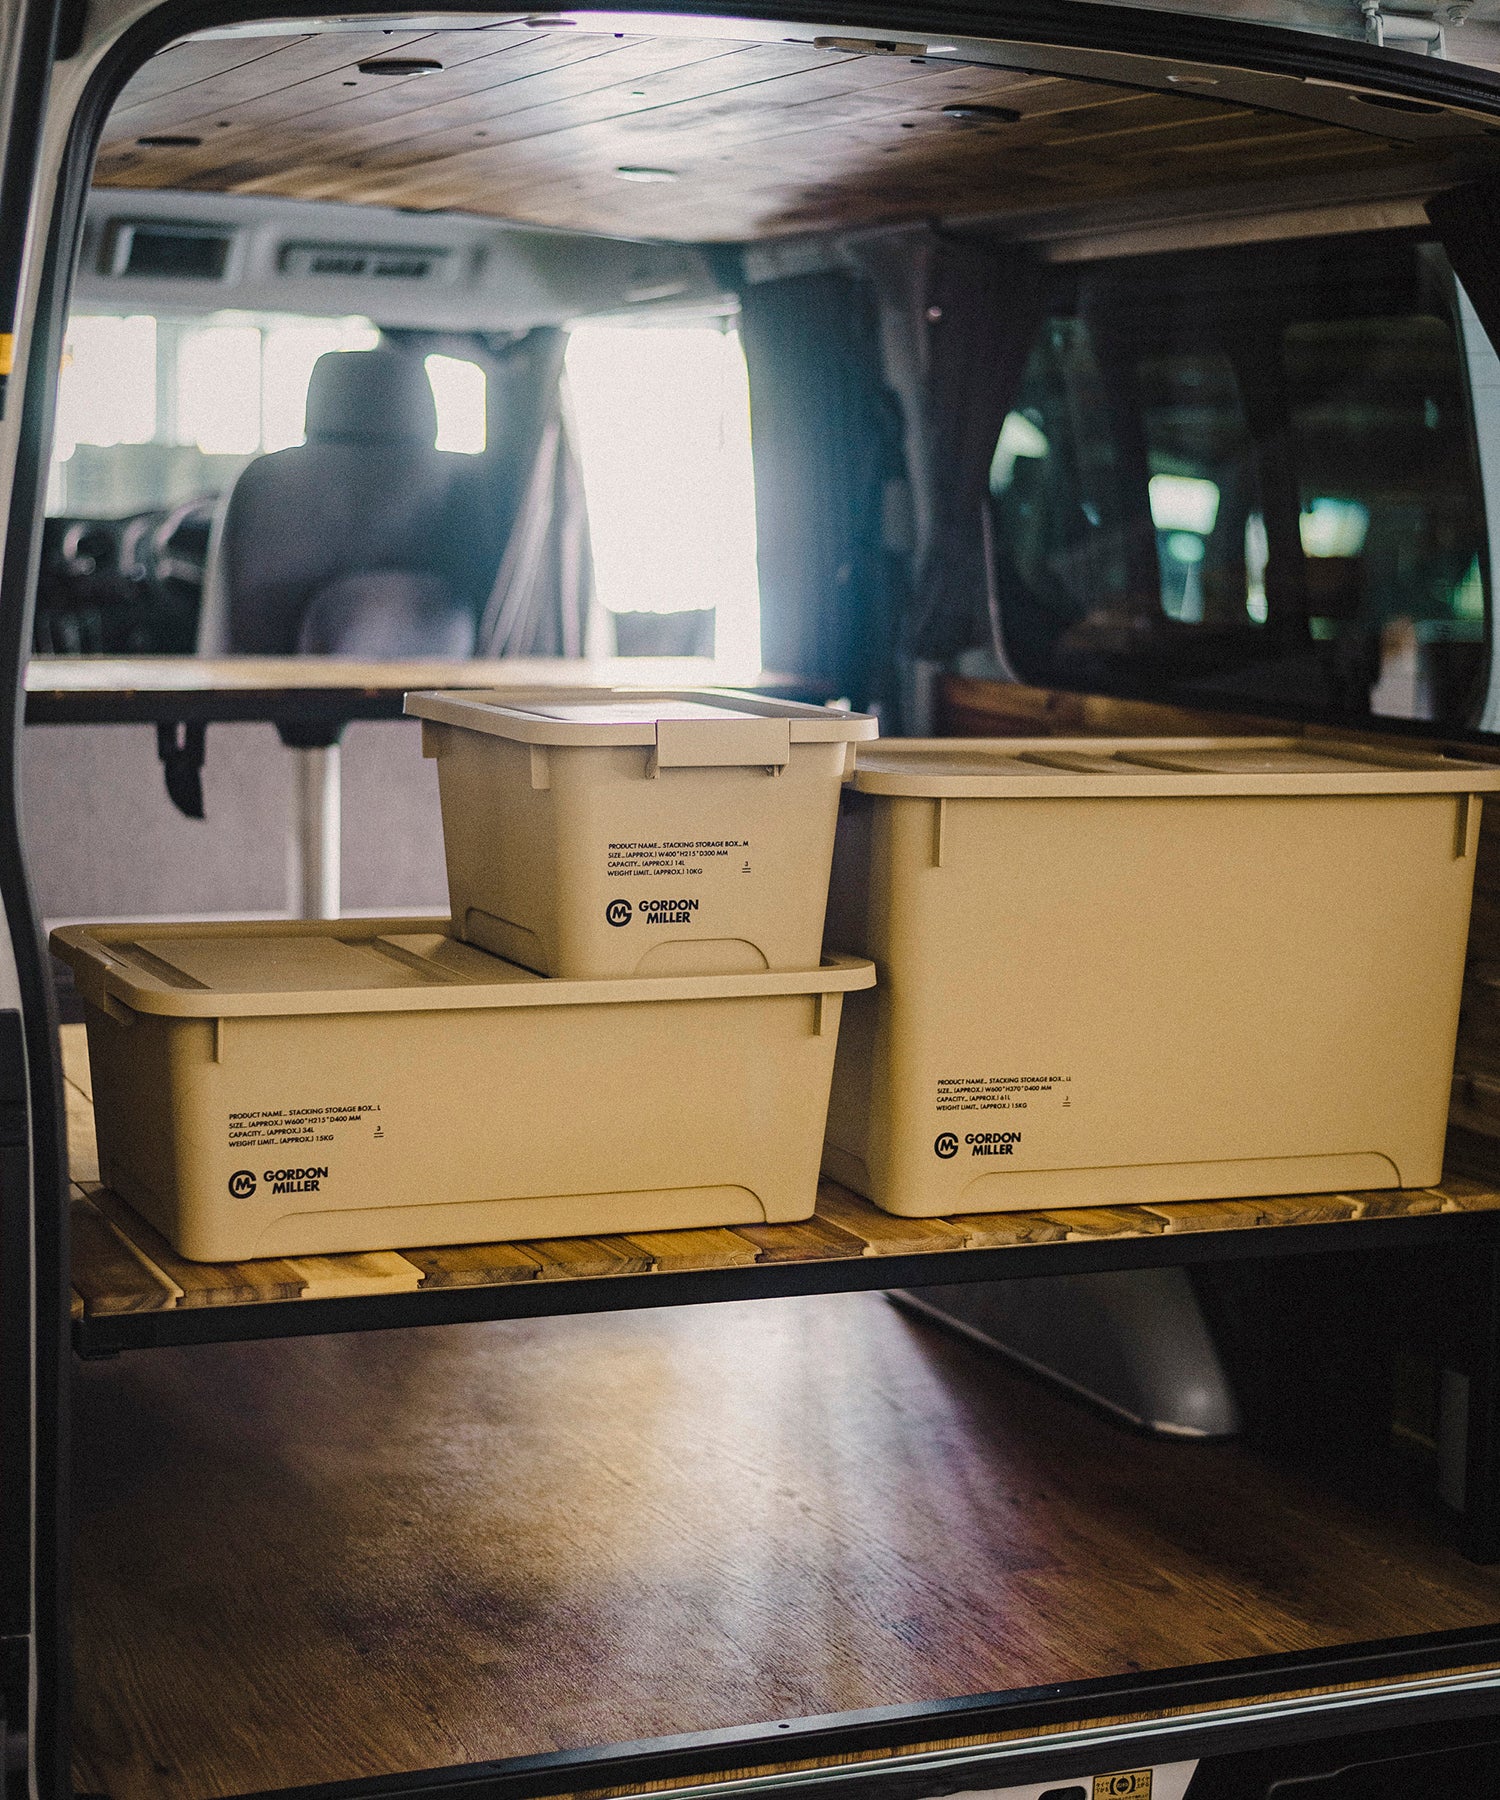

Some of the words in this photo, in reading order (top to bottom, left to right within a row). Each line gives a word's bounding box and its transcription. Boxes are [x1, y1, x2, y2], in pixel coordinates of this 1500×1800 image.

[638, 900, 699, 911] GORDON
[646, 912, 690, 924] MILLER
[229, 1112, 260, 1120] PRODUCT
[965, 1132, 1021, 1144] GORDON
[972, 1144, 1013, 1156] MILLER
[263, 1167, 328, 1181] GORDON
[272, 1181, 320, 1194] MILLER
